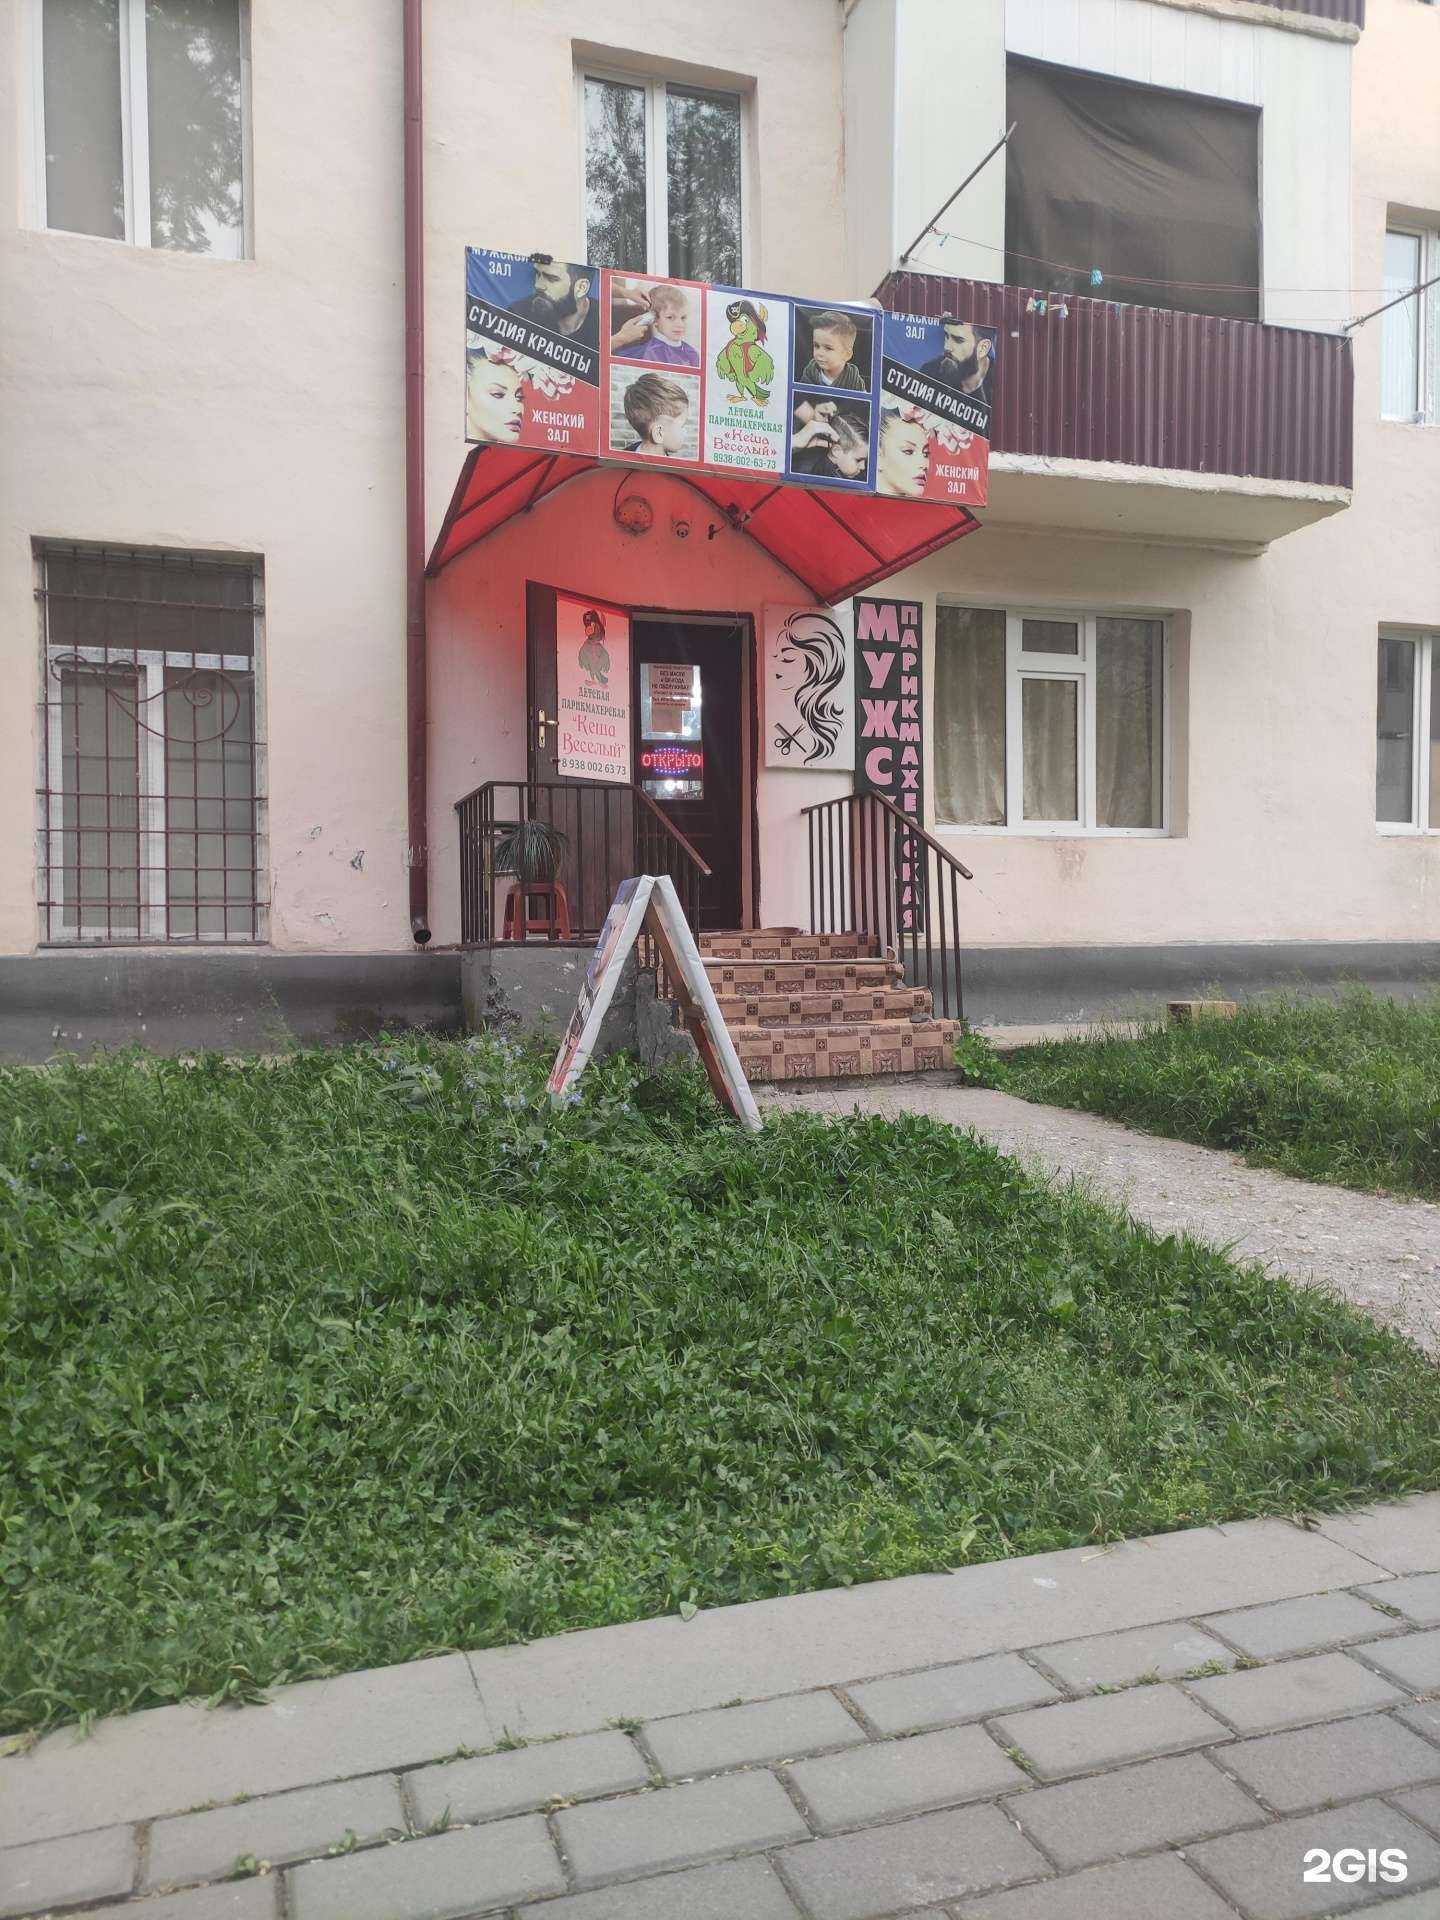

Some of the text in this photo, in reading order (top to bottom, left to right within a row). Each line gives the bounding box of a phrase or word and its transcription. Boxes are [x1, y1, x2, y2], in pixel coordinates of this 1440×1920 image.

[488, 261, 512, 277] ЗАЛ
[469, 305, 592, 374] СТУДИЯ КРАСОТЫ
[905, 325, 926, 340] ЗАЛ
[886, 367, 988, 430] СТУДИЯ КРАСОТЫ
[532, 409, 585, 429] ЖЕНСКИЙ
[728, 405, 764, 420] ДЕТСКАЯ
[708, 414, 783, 433] ПАРИКМАХЕРСКАЯ
[547, 428, 570, 443] ЗАЛ
[935, 463, 980, 480] ЖЕНСКИЙ
[947, 480, 966, 494] ЗАЛ
[578, 686, 610, 702] ДЕТСКАЯ
[561, 698, 626, 719] ПАРИКМАХЕРСКАЯ
[856, 602, 900, 804] МУЖС
[561, 758, 626, 775] 8 938 002 63 73
[642, 753, 701, 768] ОТКРЫТО
